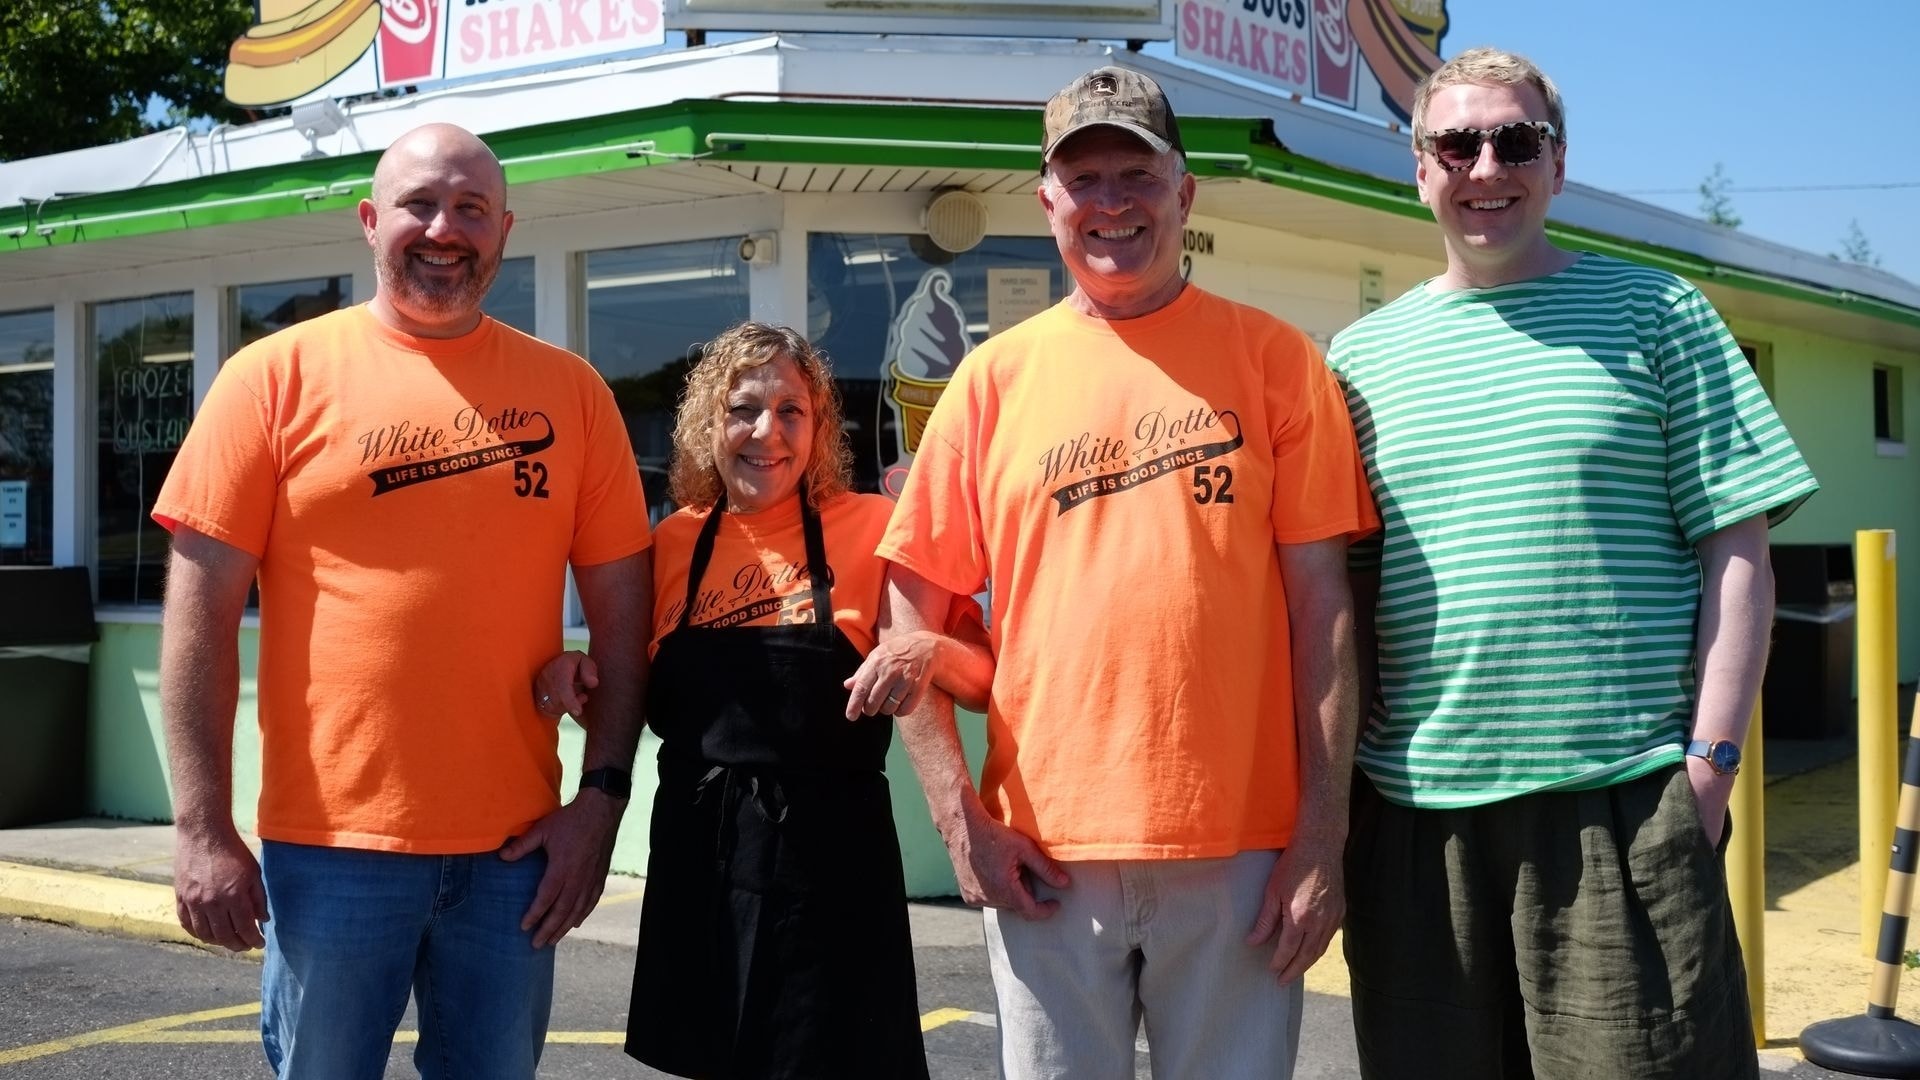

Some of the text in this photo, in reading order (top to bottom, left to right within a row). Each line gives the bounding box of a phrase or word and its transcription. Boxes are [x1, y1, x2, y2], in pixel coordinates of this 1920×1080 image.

[460, 0, 659, 63] SHAKES
[1243, 0, 1305, 29] GS
[1183, 0, 1307, 85] SHAKES
[117, 418, 191, 450] CUSTA
[358, 403, 530, 465] White Dotte
[404, 433, 505, 462] DAIRY BAR
[1039, 406, 1218, 488] White Dotte
[386, 445, 523, 485] LIFE IS GOOD SINCE
[1068, 449, 1206, 501] LIFE IS GOOD SINCE
[1085, 437, 1187, 476] DAIRY BAR
[514, 460, 550, 499] 52
[1193, 465, 1235, 505] 52
[657, 561, 809, 633] Wite Dotte
[697, 602, 737, 622] AIRY
[712, 599, 791, 628] GOOD SINCE
